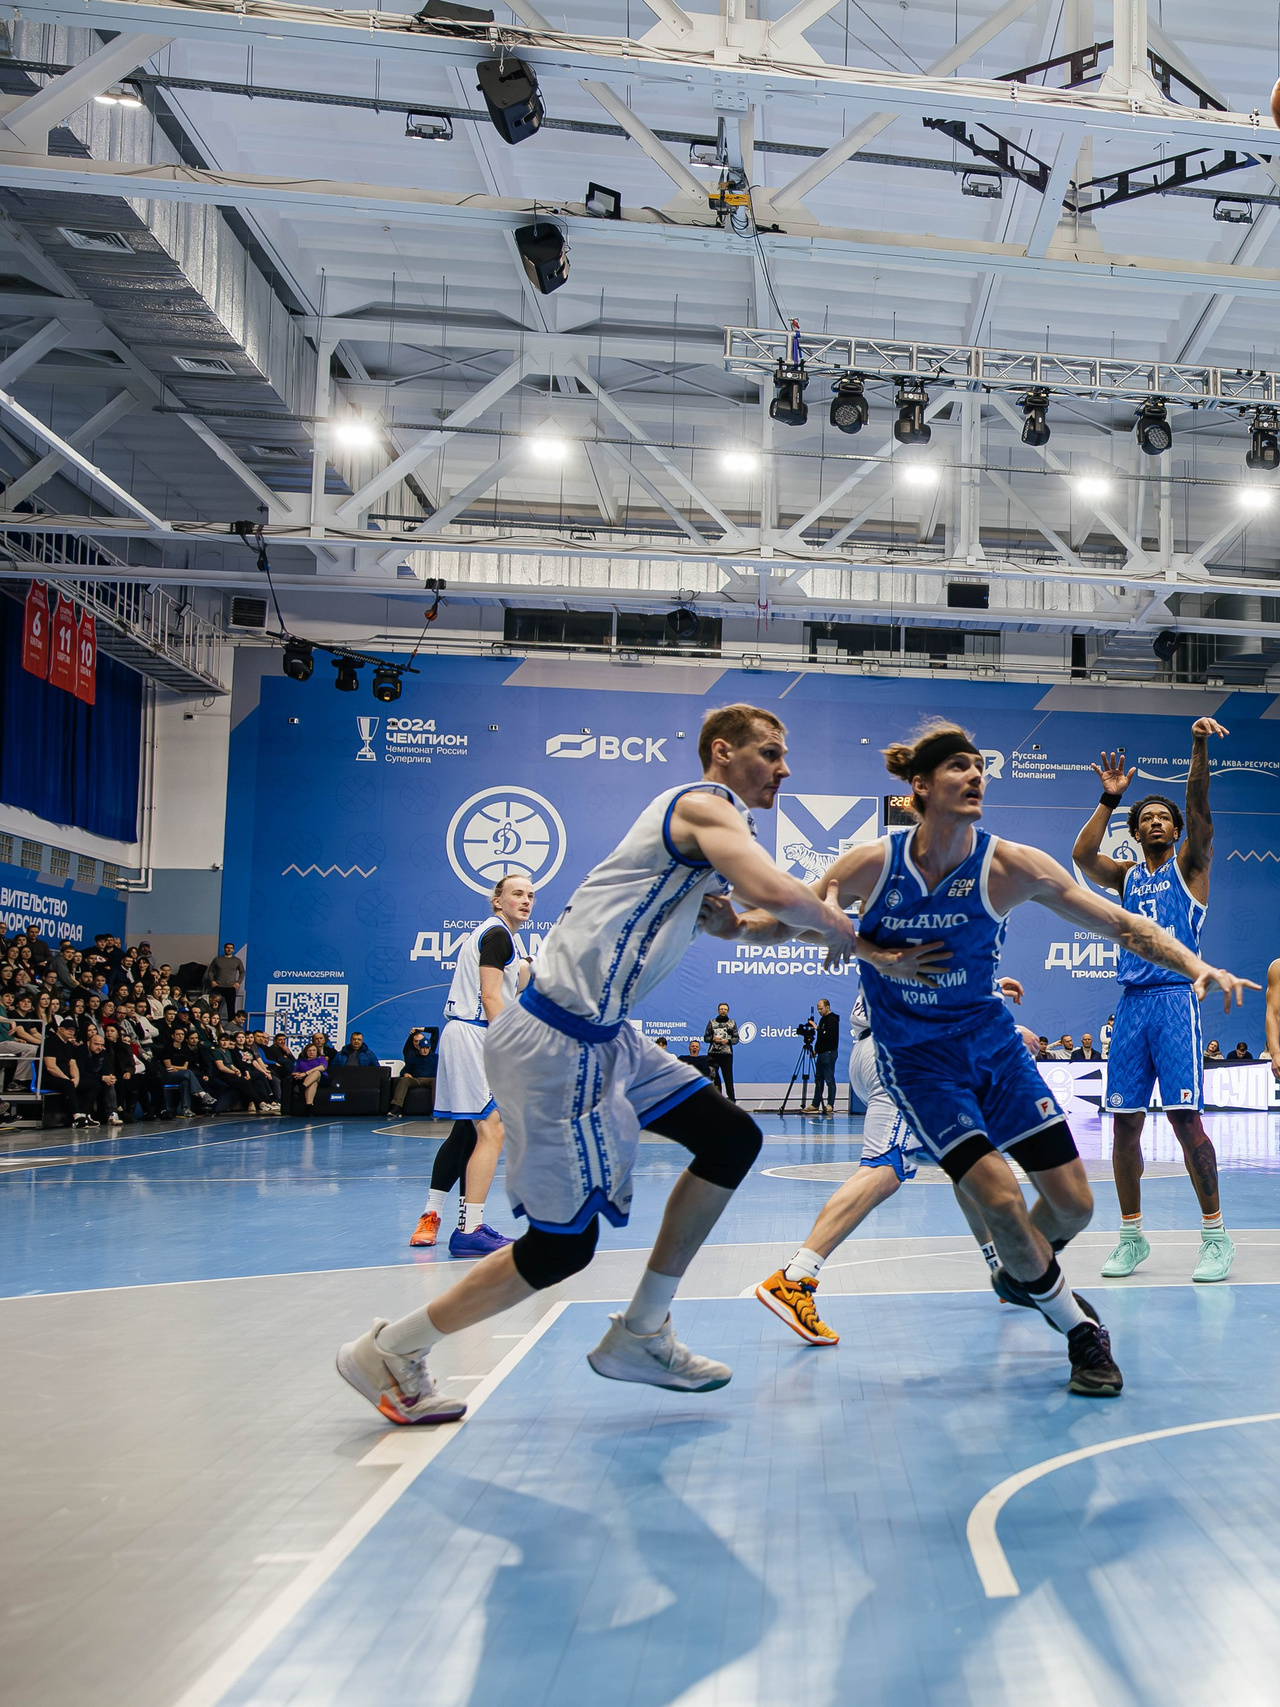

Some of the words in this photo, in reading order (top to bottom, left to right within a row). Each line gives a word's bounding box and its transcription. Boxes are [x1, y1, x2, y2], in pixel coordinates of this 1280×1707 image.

[32, 611, 42, 637] 6
[59, 626, 71, 654] 11
[80, 639, 93, 668] 10
[386, 717, 437, 732] 2024
[385, 732, 469, 746] ЧЕМПИОН
[385, 744, 434, 755] Чемпионат
[436, 746, 468, 756] России
[599, 735, 668, 764] ВСК
[384, 754, 432, 765] Суперлига
[1011, 751, 1048, 762] Русская
[1137, 756, 1169, 765] ГРУППА
[1221, 759, 1280, 769] АКВА-РЕСУРСЫ
[1011, 770, 1056, 780] Компания
[951, 878, 976, 888] FON
[947, 887, 973, 897] BET
[0, 886, 68, 918] ВИТЕЛЬСТВО
[57, 921, 83, 943] КРАЯ
[273, 970, 345, 979] @DYNAMO25PRIM
[645, 1021, 688, 1029] ТЕЛЕВИДЕНИЕ
[760, 1025, 799, 1038] slavda
